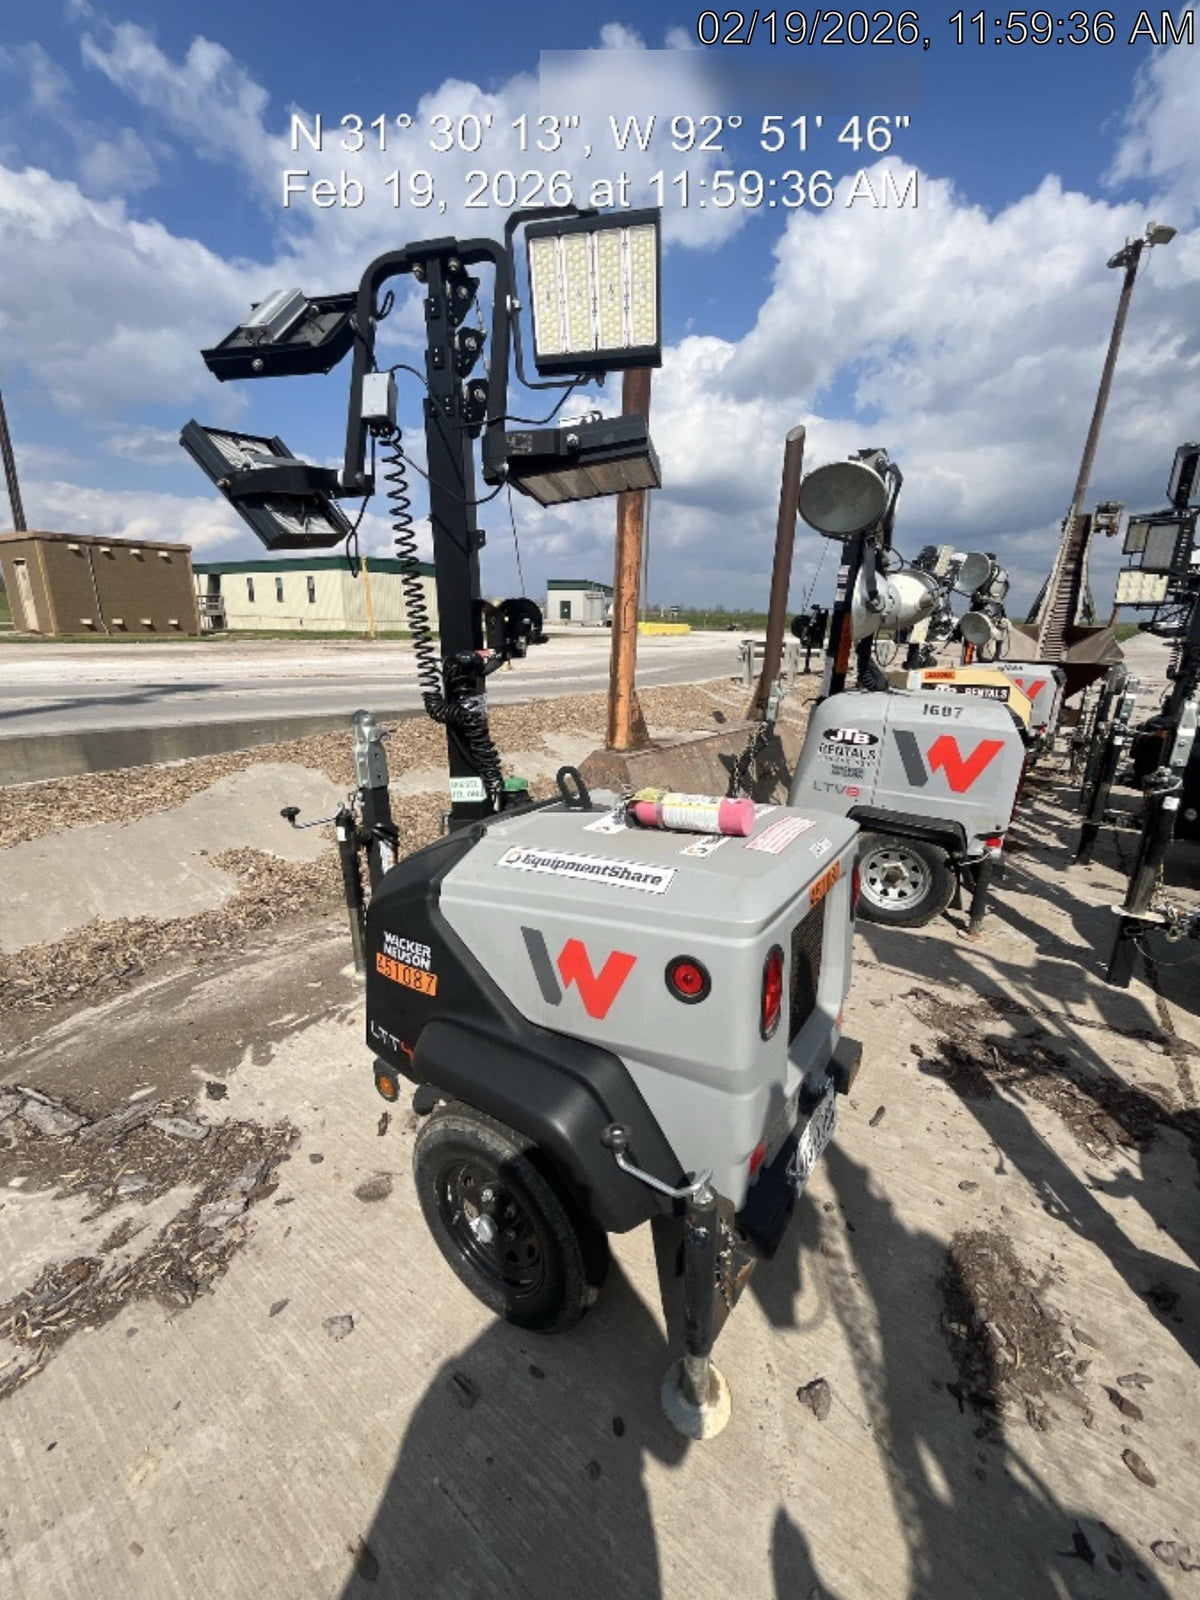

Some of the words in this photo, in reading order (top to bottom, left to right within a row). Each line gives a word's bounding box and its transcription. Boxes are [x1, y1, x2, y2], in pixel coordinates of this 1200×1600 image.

[830, 728, 871, 745] JTB
[522, 853, 663, 887] EquipmentShare
[383, 931, 432, 958] WACKER
[383, 943, 431, 971] NEUSON
